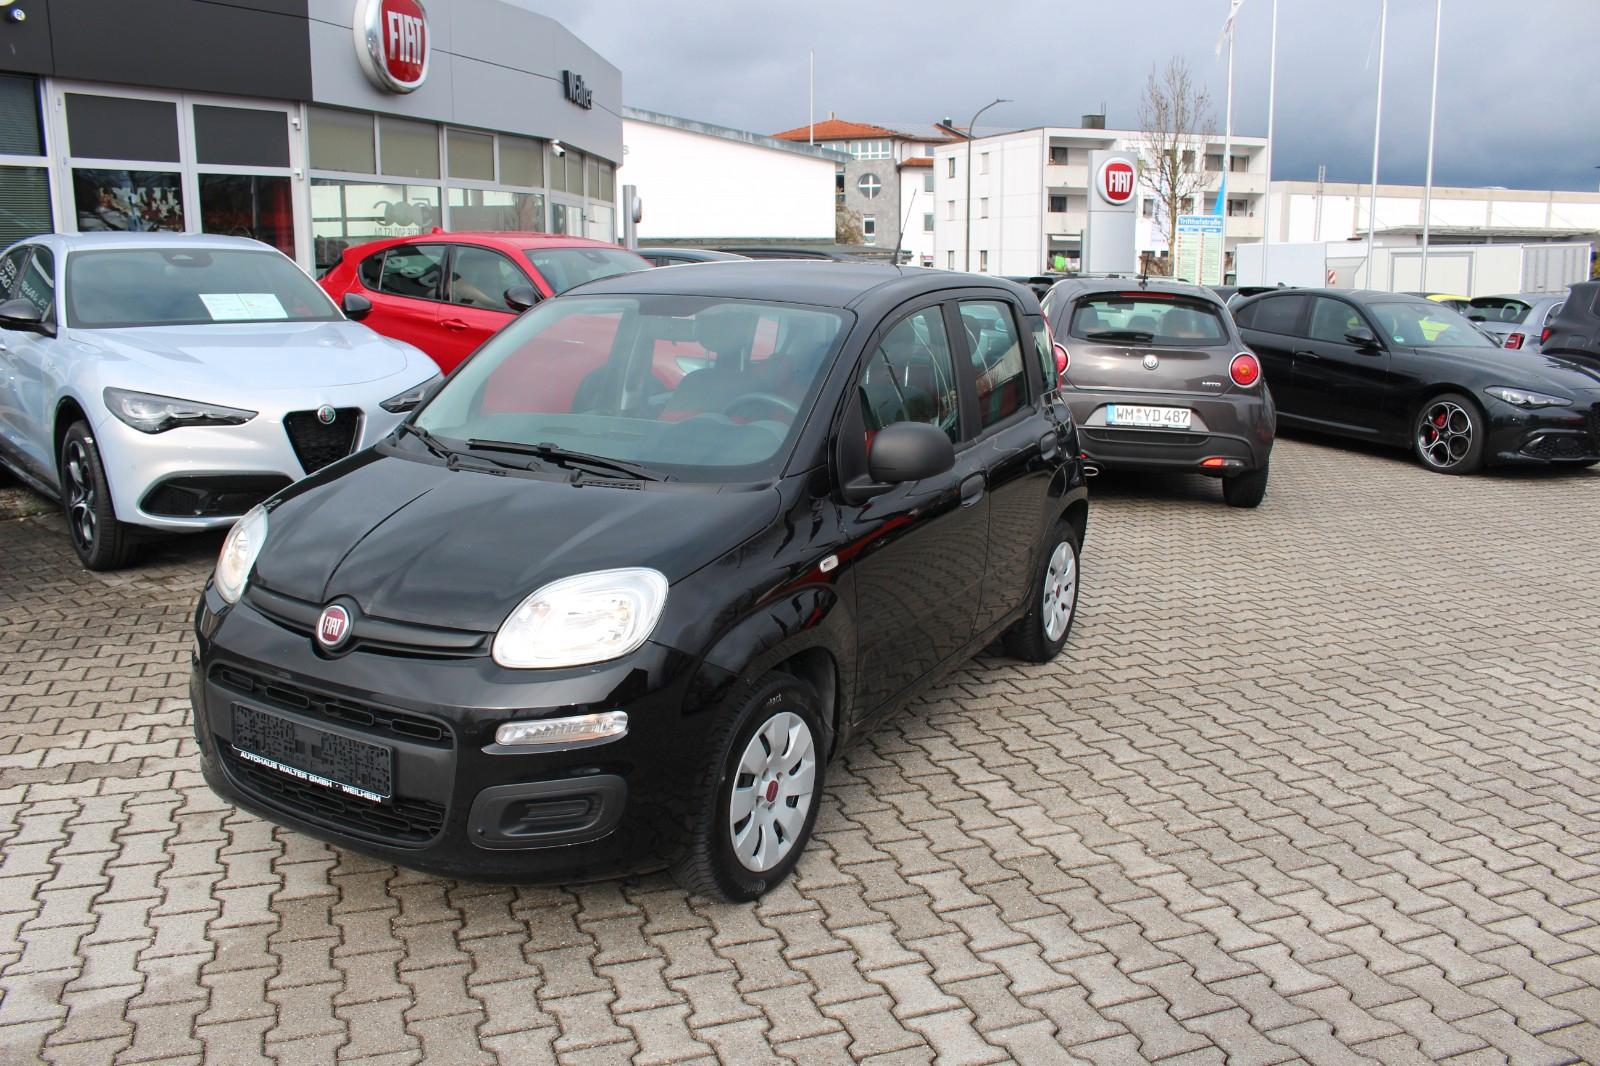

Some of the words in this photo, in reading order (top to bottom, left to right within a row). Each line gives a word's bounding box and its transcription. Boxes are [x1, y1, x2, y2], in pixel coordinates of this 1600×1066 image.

[387, 10, 423, 64] FIAT
[562, 70, 592, 110] Walter
[1108, 170, 1132, 193] FIAT
[1116, 406, 1134, 420] WM
[1143, 408, 1161, 421] YD
[1163, 410, 1189, 424] 487
[323, 615, 344, 637] FIAT
[240, 751, 278, 770] AUTOHAUS
[278, 763, 308, 781] WALTER
[309, 775, 332, 788] GMBH
[342, 783, 381, 803] WEILHEIM
